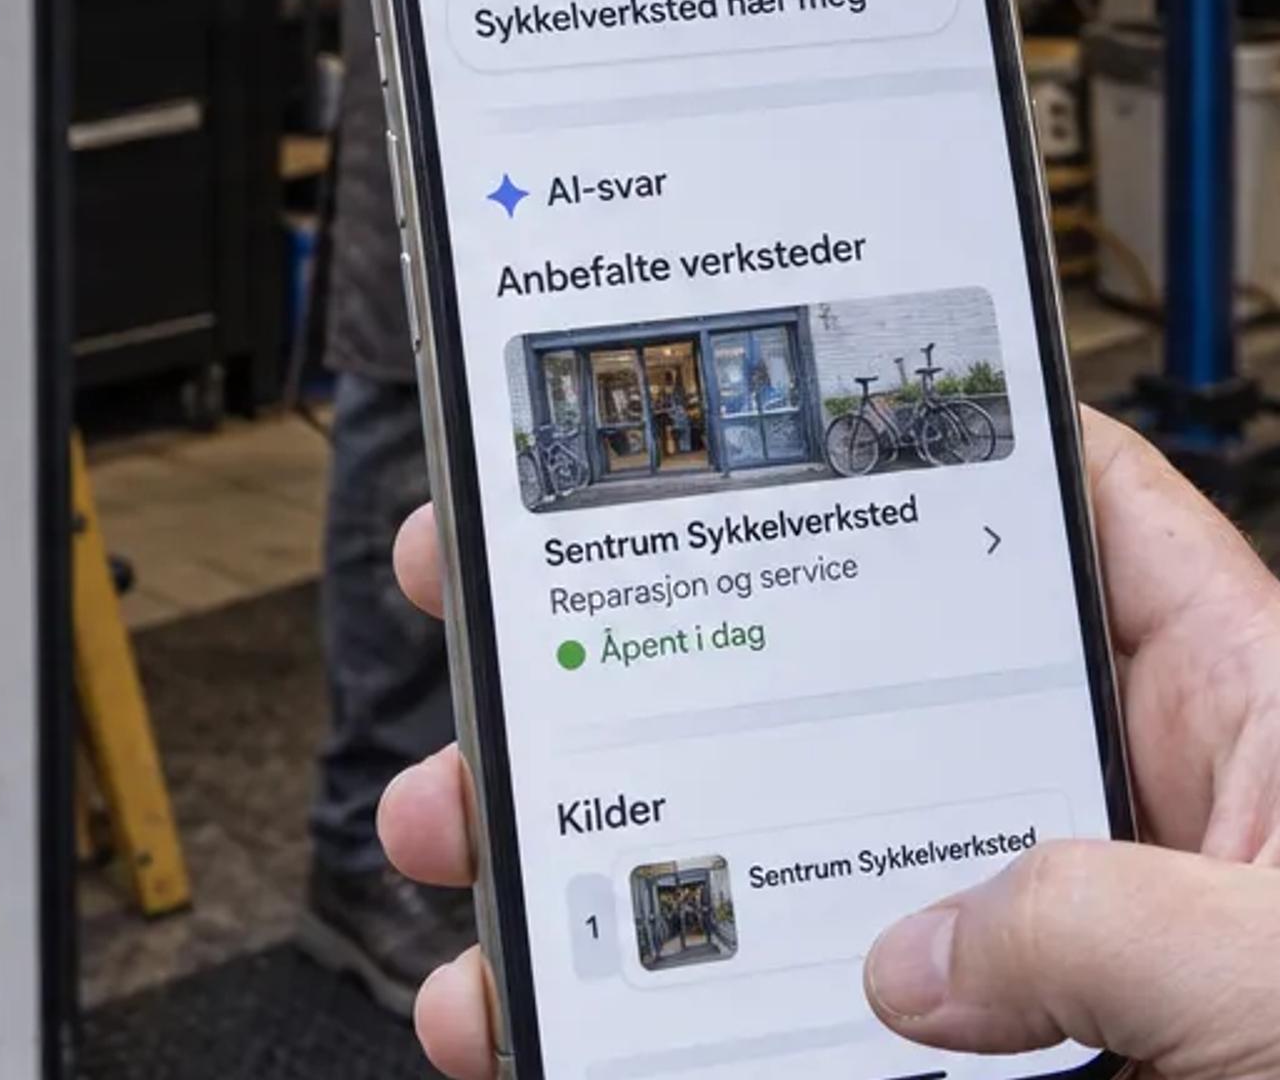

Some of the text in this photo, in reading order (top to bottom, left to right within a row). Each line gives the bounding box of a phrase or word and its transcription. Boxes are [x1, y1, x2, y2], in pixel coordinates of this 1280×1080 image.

[547, 173, 667, 207] AI-svar
[497, 233, 867, 298] Anbefalte verksteder
[544, 493, 919, 567] Sentrum Sykkelverksted
[550, 556, 858, 617] Reparasjon og service
[600, 620, 766, 666] Åpent i dag
[557, 794, 667, 836] Kilder
[748, 826, 1037, 889] Sentrum Sykkelverksted
[585, 915, 599, 939] 1
